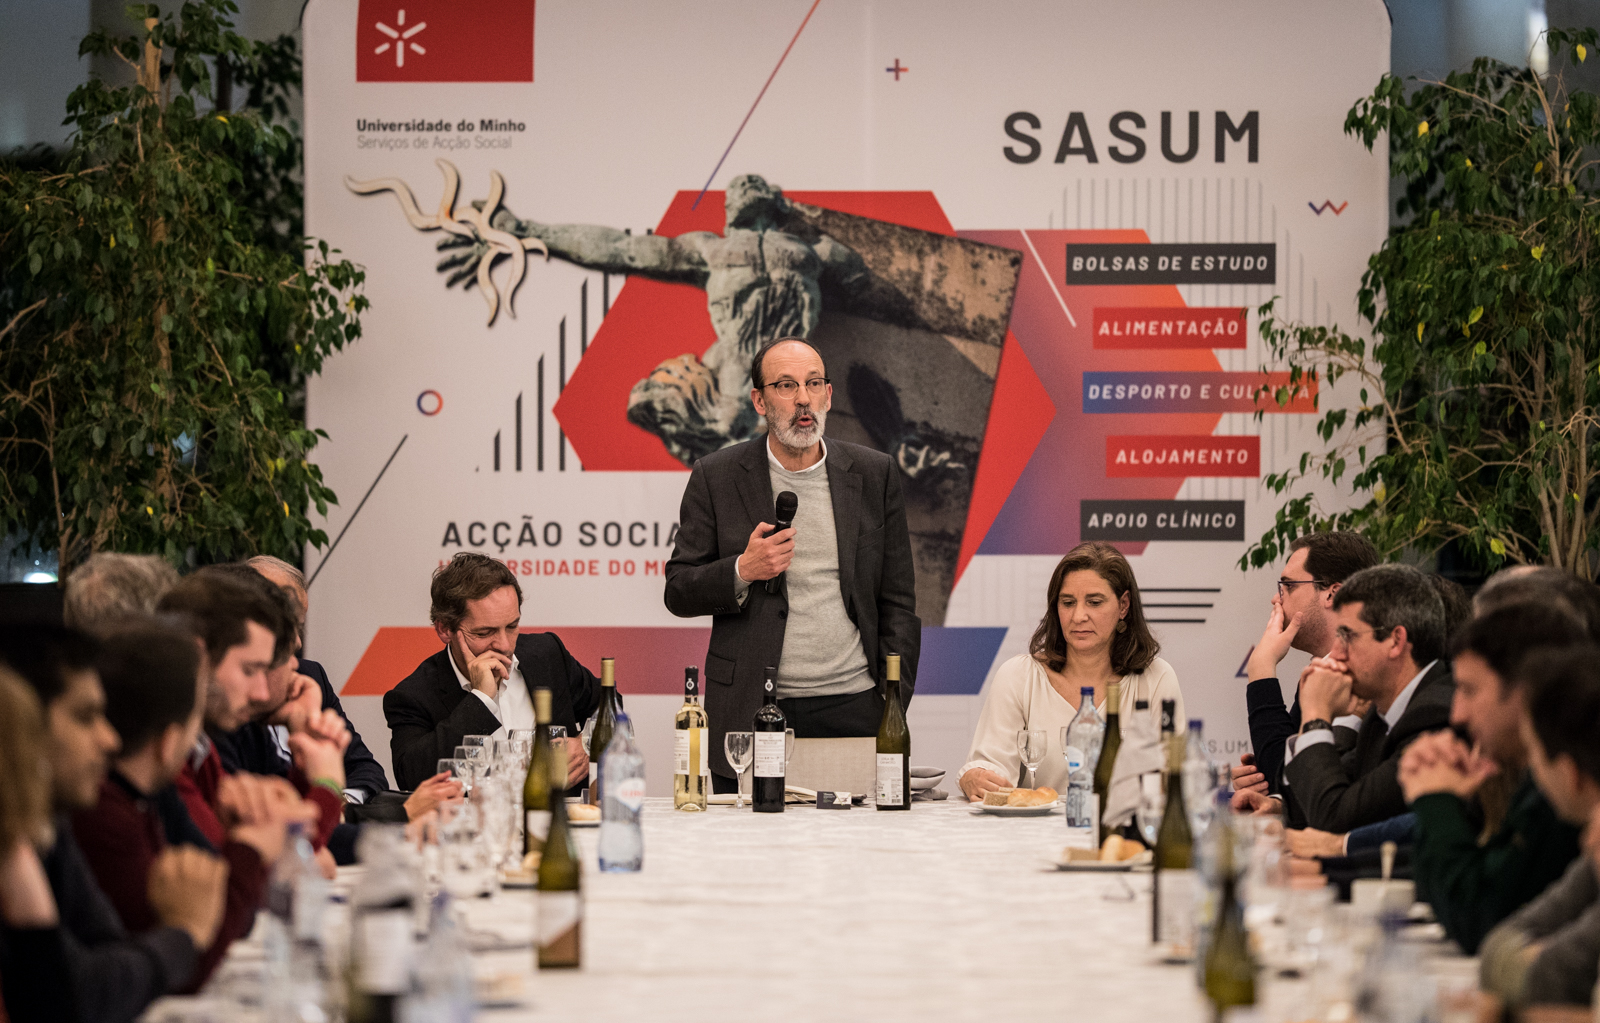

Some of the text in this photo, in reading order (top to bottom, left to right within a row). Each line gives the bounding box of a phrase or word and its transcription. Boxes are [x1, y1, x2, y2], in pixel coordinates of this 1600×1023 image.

[356, 119, 526, 132] Universidade do Minho
[357, 135, 512, 150] Serviços de Acção Social
[1003, 111, 1259, 164] SASUM
[1072, 256, 1268, 271] BOLSAS DE ESTUDO
[1098, 318, 1239, 339] ALIMENTAÇÃO
[1088, 385, 1192, 400] DESPORTO
[1200, 385, 1211, 399] E
[1115, 449, 1248, 465] ALOJAMENTO
[1088, 511, 1237, 529] APOIO CLÍNICO
[442, 515, 681, 553] ACÇÃO SOCIA
[608, 560, 636, 576] DO
